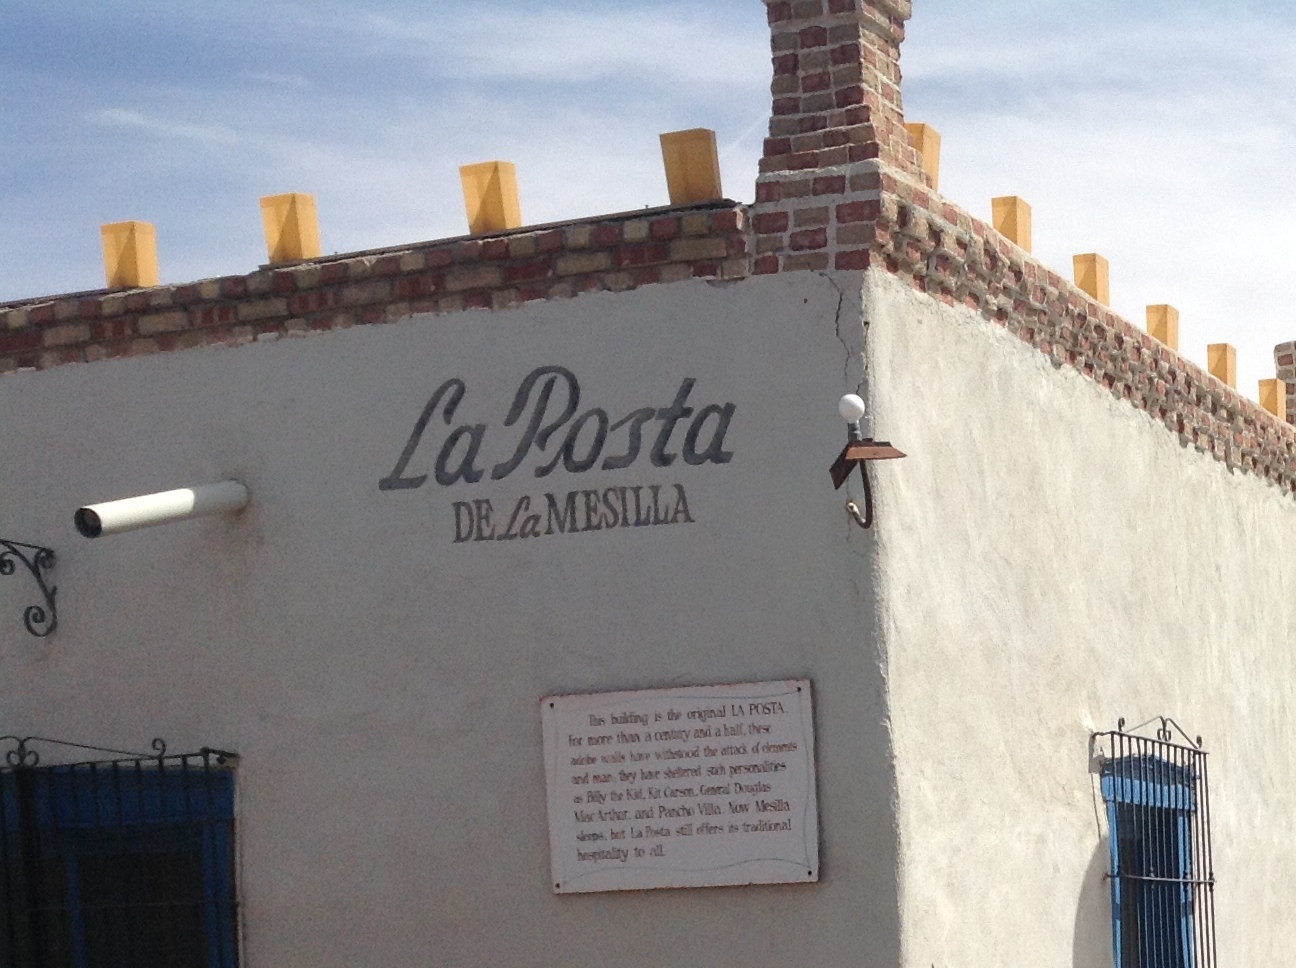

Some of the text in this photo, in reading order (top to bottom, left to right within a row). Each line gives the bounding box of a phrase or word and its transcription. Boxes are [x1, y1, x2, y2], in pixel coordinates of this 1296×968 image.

[378, 365, 737, 491] La Posta
[451, 483, 696, 543] DE La MESILLA
[611, 712, 648, 726] building
[655, 714, 662, 722] is
[667, 709, 681, 720] the
[687, 705, 726, 722] original
[732, 705, 744, 716] LA
[750, 702, 788, 715] POSTA.
[588, 736, 612, 746] more
[617, 731, 640, 743] than
[645, 732, 651, 742] a
[655, 730, 690, 742] century
[694, 726, 711, 738] and
[715, 728, 721, 736] a
[749, 722, 771, 734] these
[570, 742, 797, 765] adobe walls have withstood the attack of elements
[571, 772, 588, 784] and
[619, 770, 636, 784] they
[640, 769, 660, 780] have
[663, 766, 701, 779] sheltered
[707, 763, 726, 776] such
[729, 761, 786, 778] personalities
[573, 795, 583, 803] as
[587, 791, 606, 804] Billy
[610, 790, 623, 801] the
[648, 786, 661, 799] Kit
[700, 783, 730, 795] General
[735, 782, 771, 796] Douglas
[635, 807, 654, 819] and
[659, 805, 695, 818] Pancho
[729, 801, 750, 814] Now
[756, 799, 790, 812] Mesilla
[611, 828, 625, 840] but
[631, 827, 642, 838] La
[646, 826, 670, 837] Posta
[676, 824, 693, 836] still
[697, 823, 724, 834] offers
[729, 822, 739, 833] its
[742, 819, 791, 832] traditional
[577, 847, 628, 862] hospitality
[634, 847, 645, 857] to
